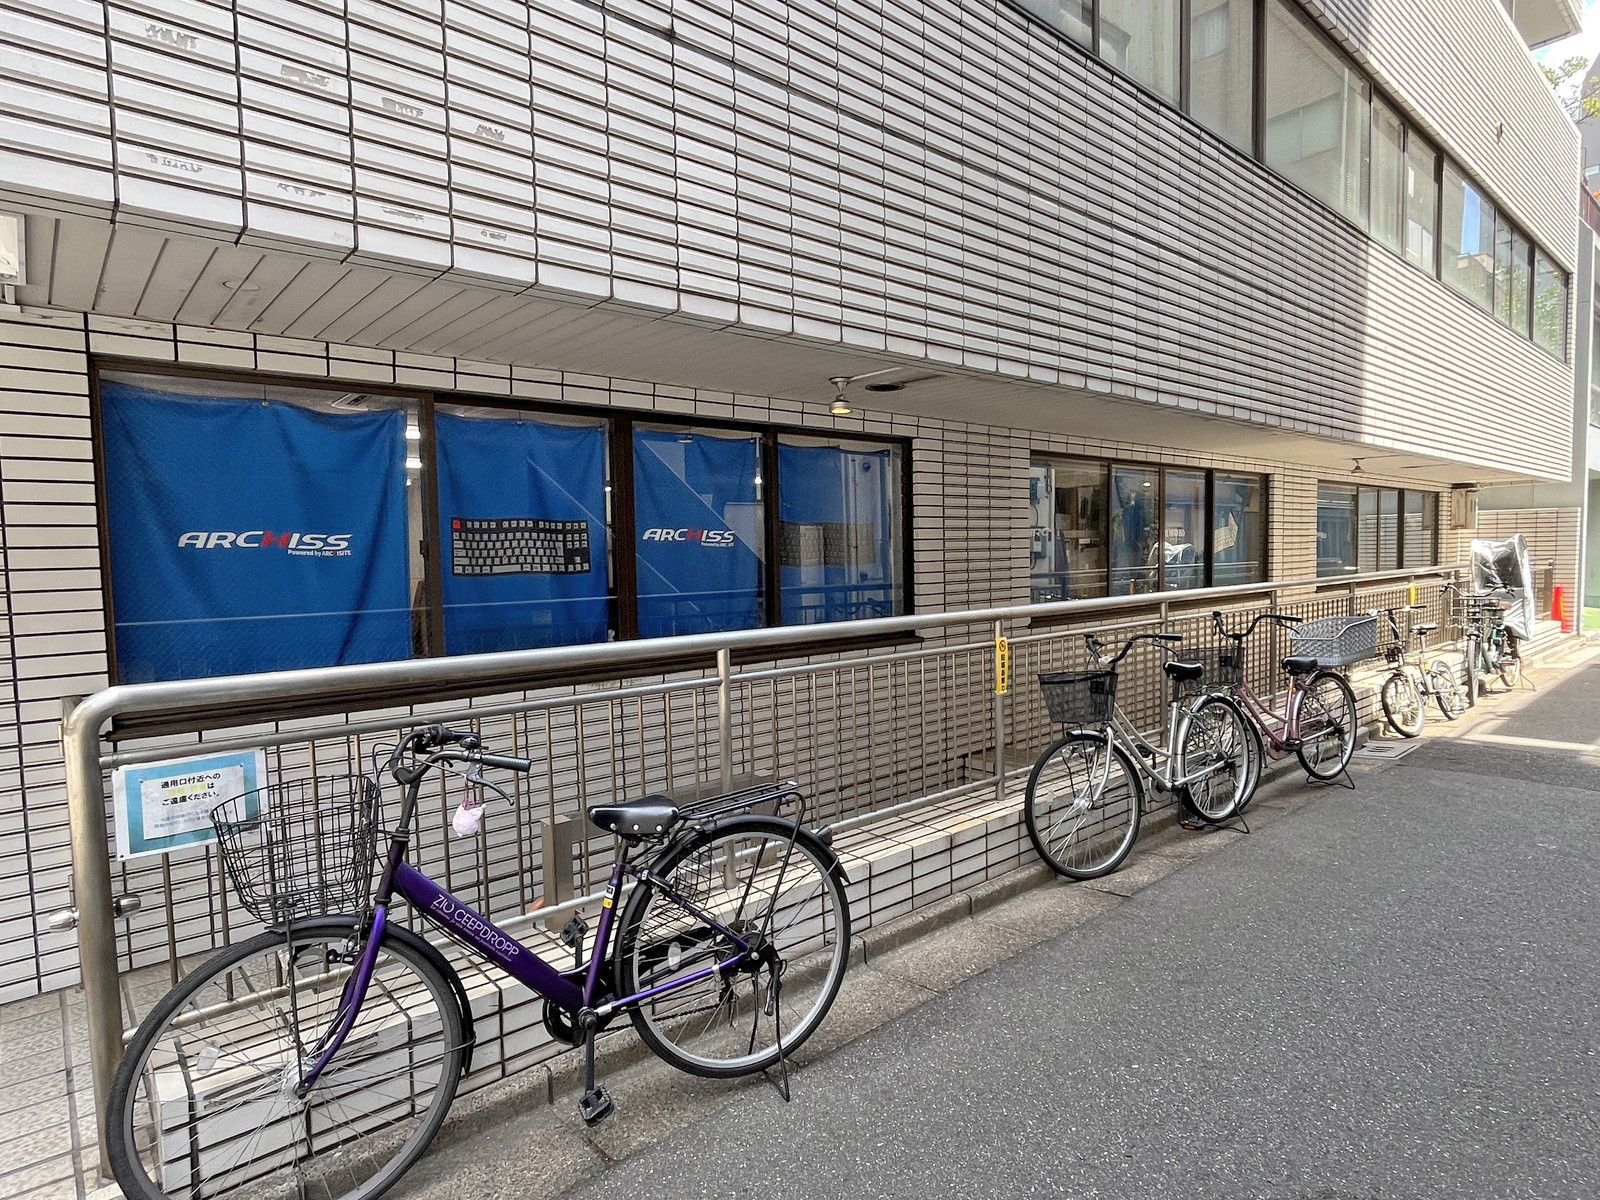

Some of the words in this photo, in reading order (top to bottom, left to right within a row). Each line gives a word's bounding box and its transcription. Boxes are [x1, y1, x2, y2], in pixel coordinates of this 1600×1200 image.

[177, 530, 353, 550] ARCHISS
[642, 527, 735, 543] ARCHISS
[454, 909, 520, 956] CEEPDROPP
